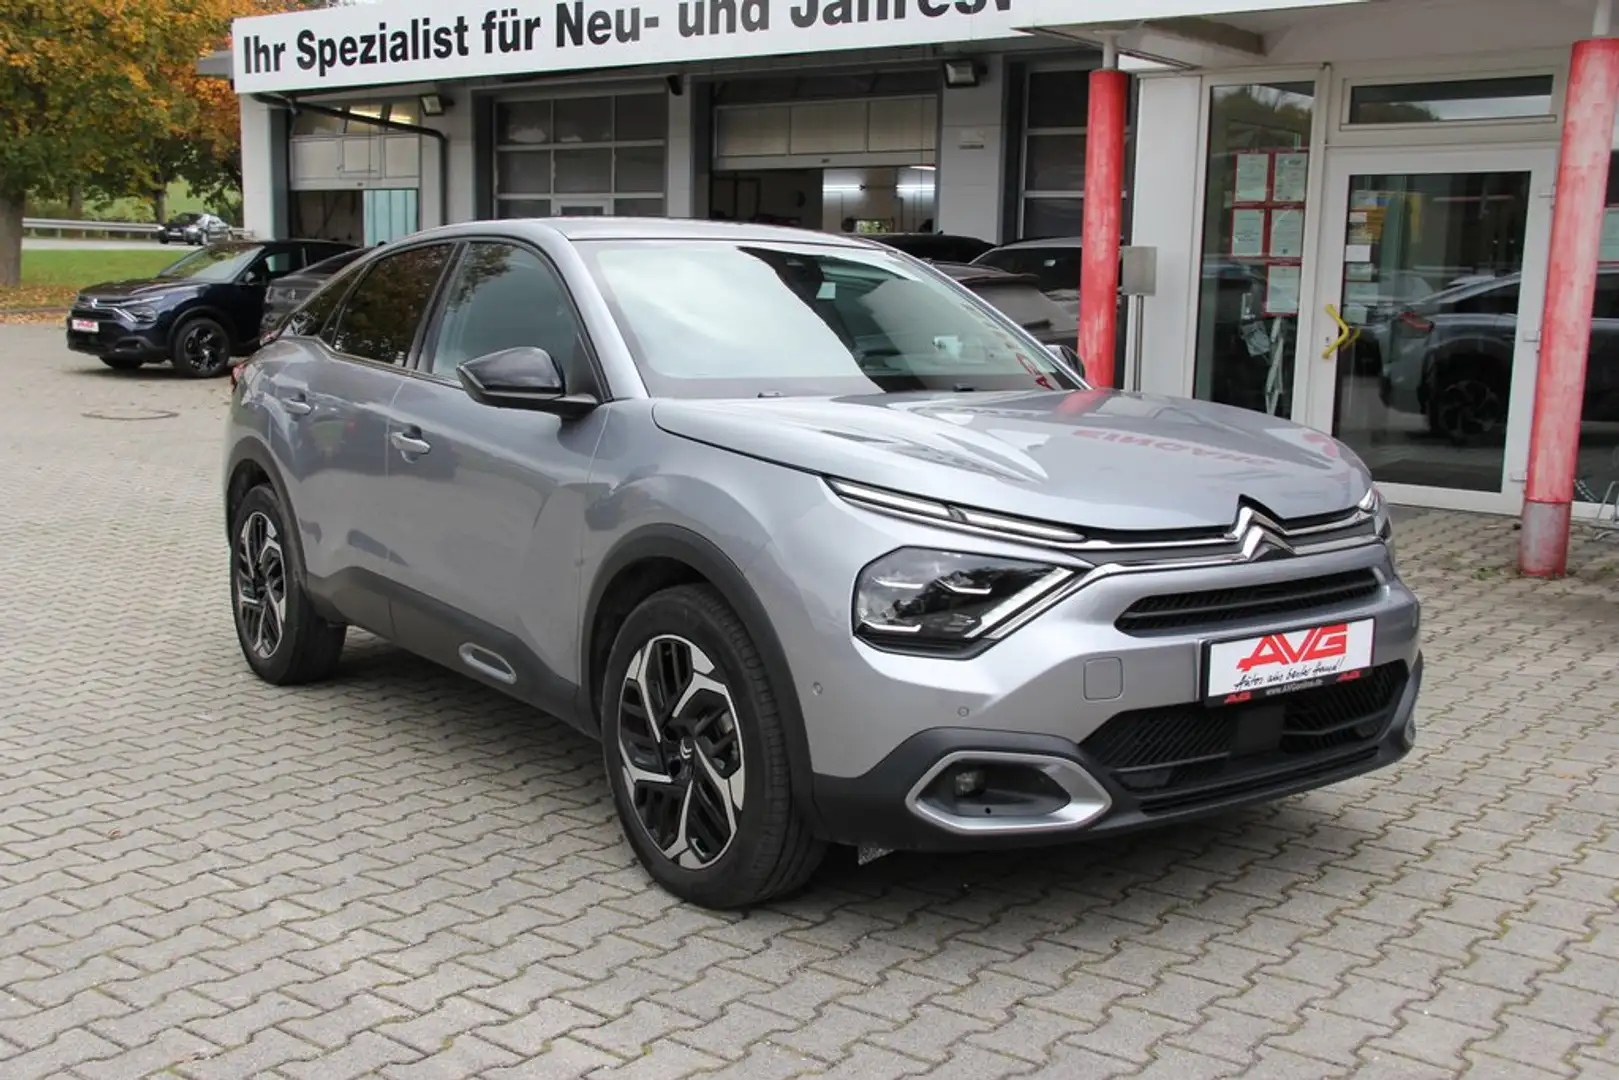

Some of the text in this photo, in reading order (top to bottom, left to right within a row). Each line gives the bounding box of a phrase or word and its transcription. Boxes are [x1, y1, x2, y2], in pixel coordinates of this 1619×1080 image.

[243, 35, 286, 74] Ihr
[296, 15, 469, 77] Spezialist
[481, 7, 541, 54] für
[556, 1, 659, 48] Neu-
[678, 0, 770, 38] und
[1236, 622, 1348, 672] AVG
